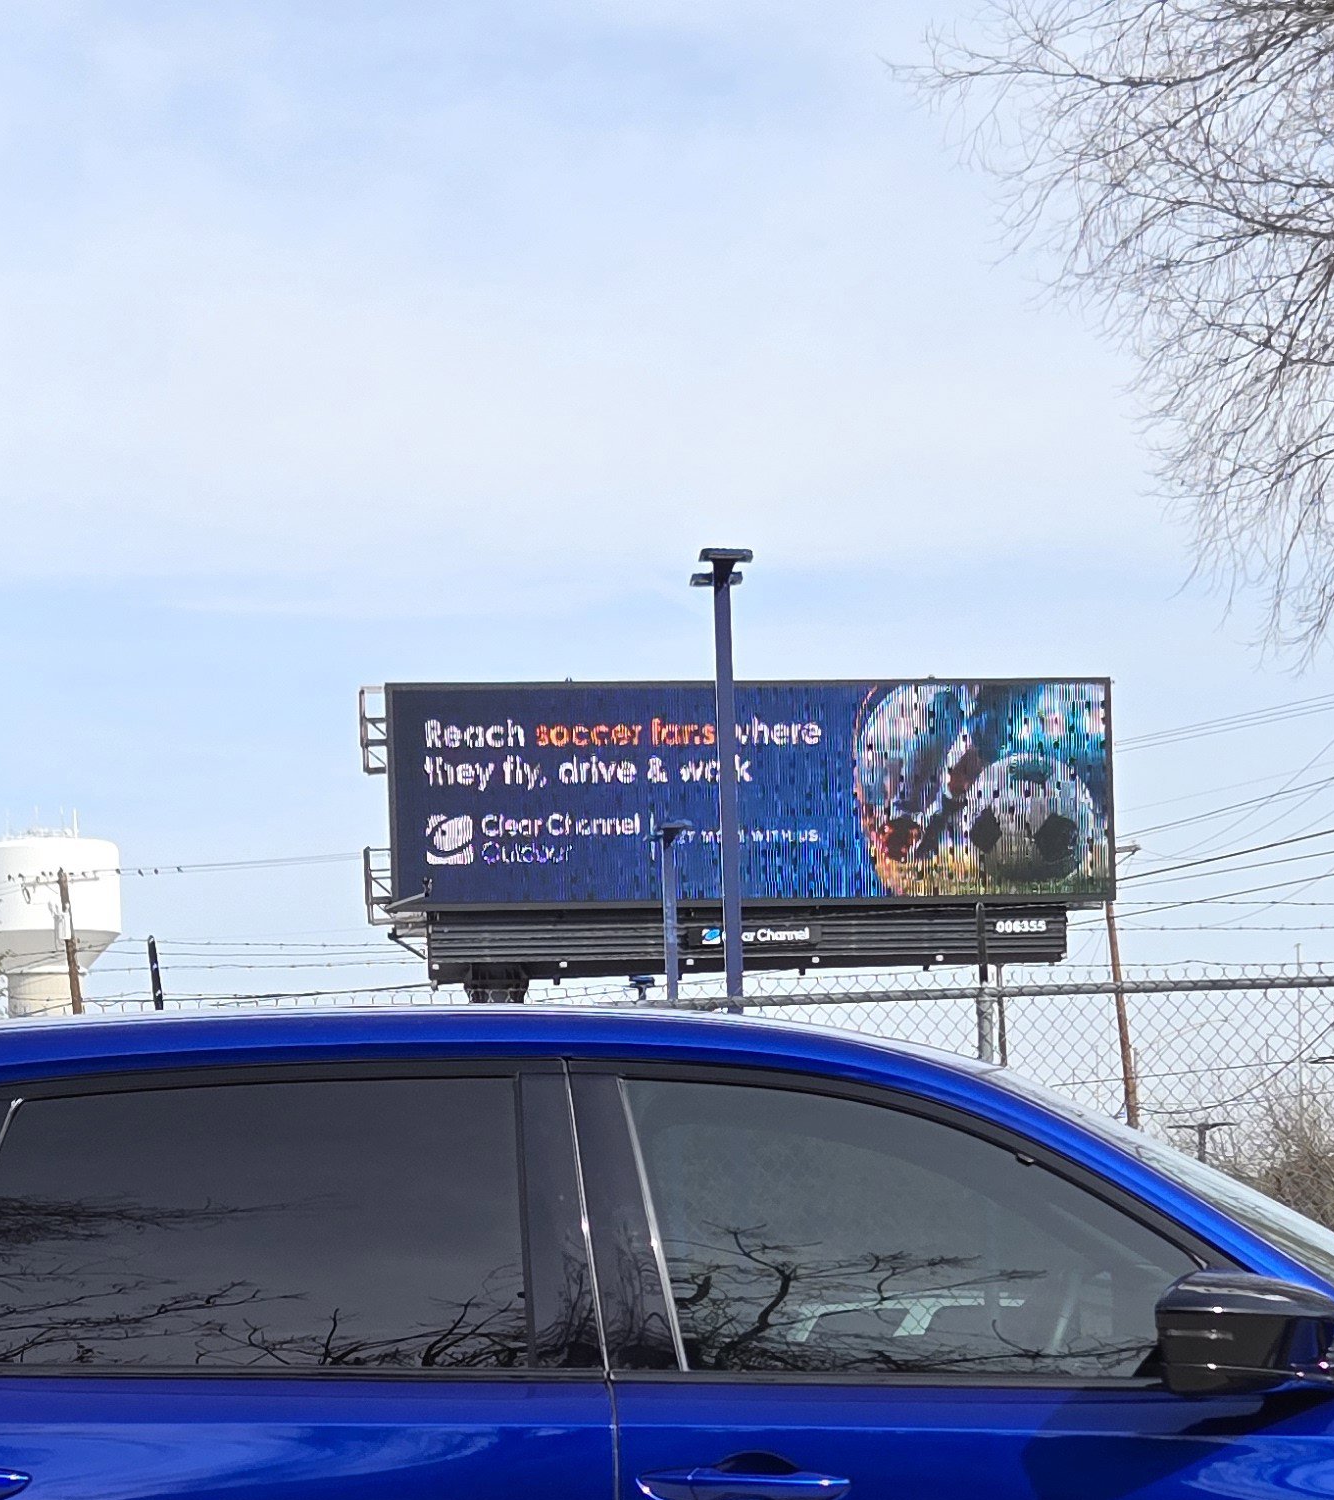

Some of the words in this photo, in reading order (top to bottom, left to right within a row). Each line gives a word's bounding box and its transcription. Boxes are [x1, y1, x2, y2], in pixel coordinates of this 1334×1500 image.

[424, 718, 525, 748] Reach
[535, 722, 642, 748] soccer
[651, 716, 716, 747] fans
[423, 754, 495, 792] they
[502, 754, 547, 791] fly,
[558, 753, 637, 785] drive
[647, 754, 668, 784] &
[679, 753, 753, 783] wok
[481, 813, 543, 838] Clear
[546, 811, 640, 838] Channel
[757, 926, 810, 942] Channel
